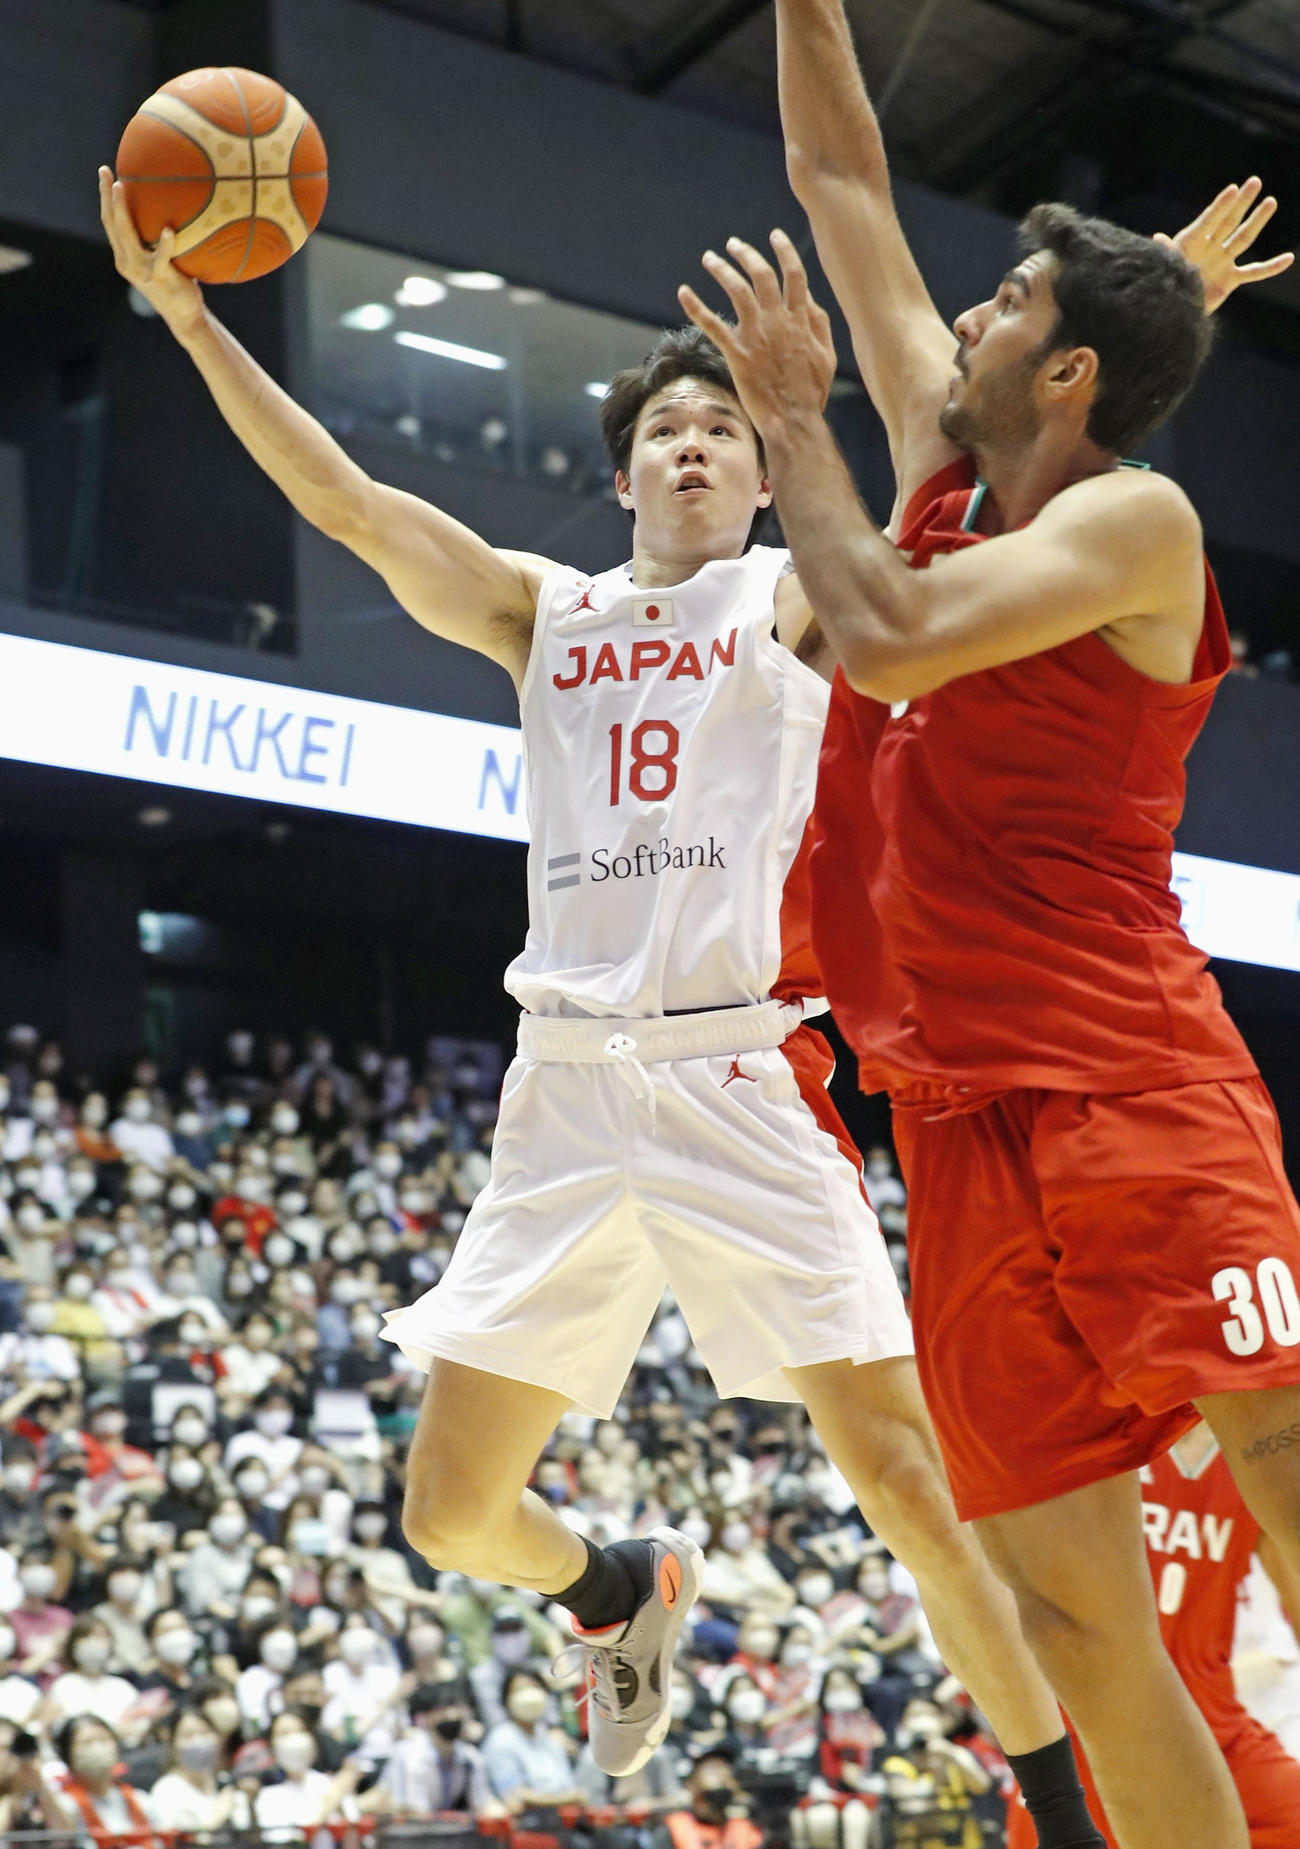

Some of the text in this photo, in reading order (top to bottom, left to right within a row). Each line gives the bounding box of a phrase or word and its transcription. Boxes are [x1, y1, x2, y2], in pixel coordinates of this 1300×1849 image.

[553, 627, 738, 690] JAPAN
[124, 684, 355, 787] NIKKEI
[609, 719, 680, 807] 18
[590, 836, 727, 882] SoftBank
[1211, 1257, 1300, 1356] 30
[1141, 1502, 1234, 1562] RAN
